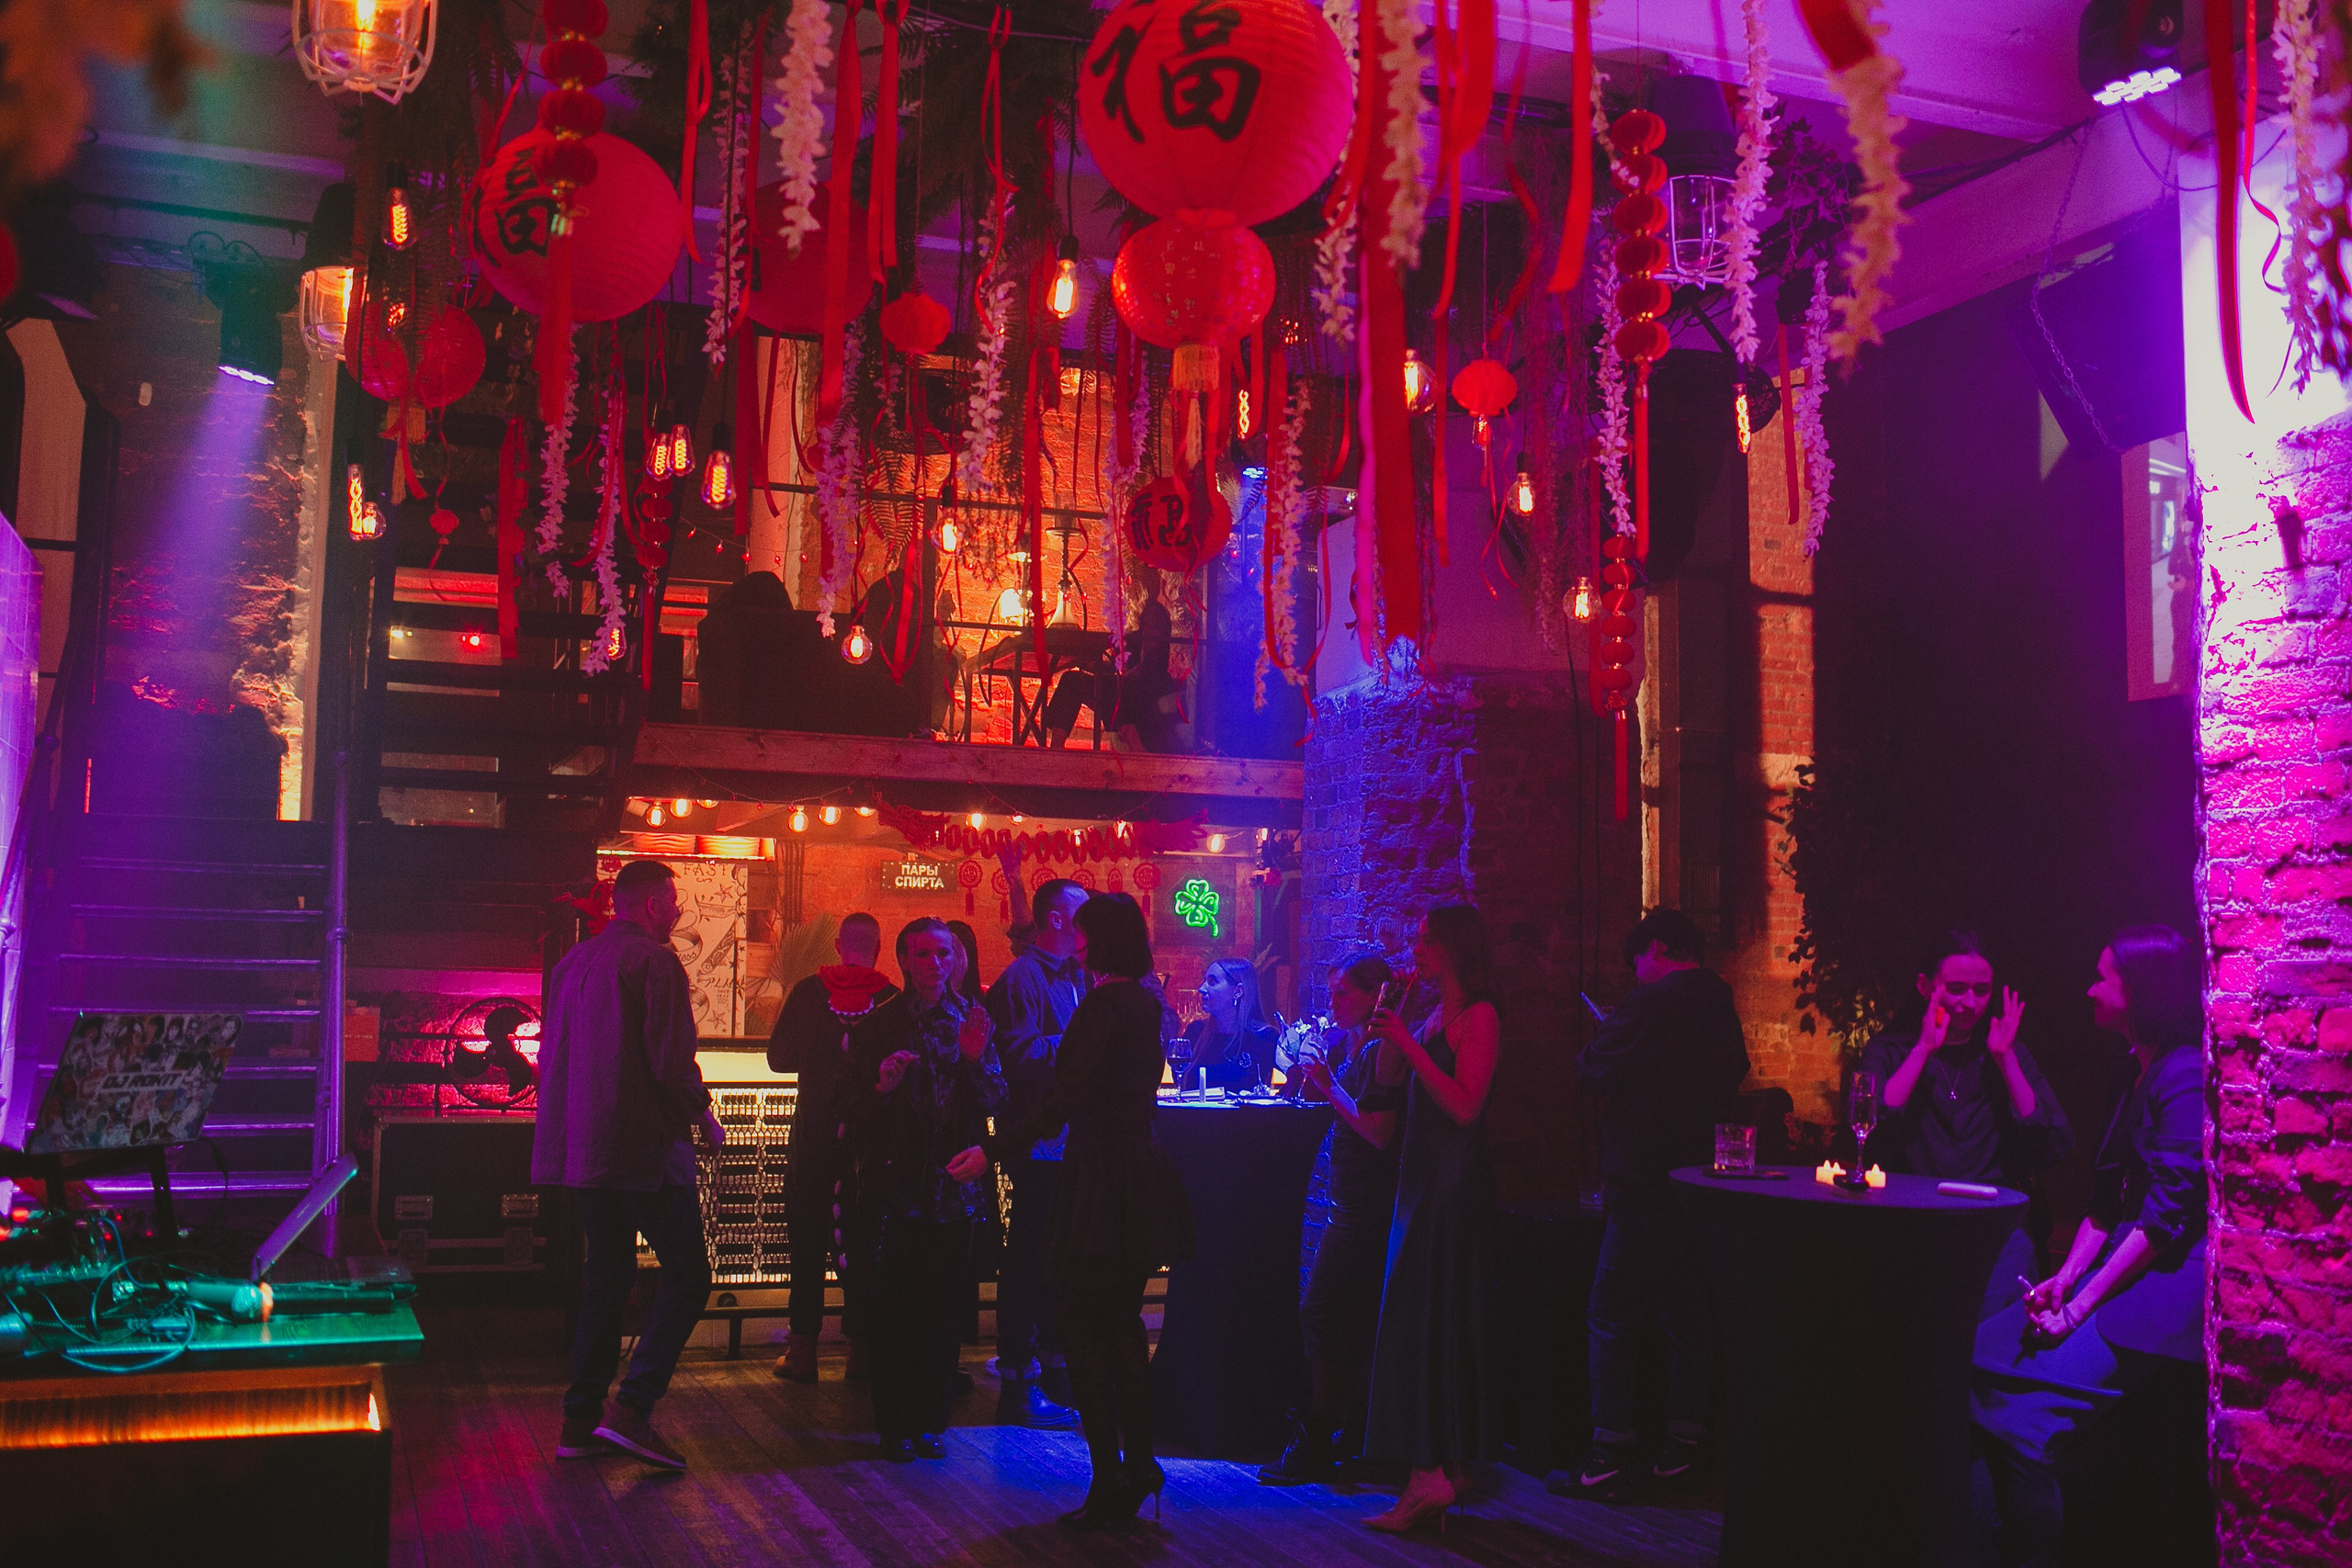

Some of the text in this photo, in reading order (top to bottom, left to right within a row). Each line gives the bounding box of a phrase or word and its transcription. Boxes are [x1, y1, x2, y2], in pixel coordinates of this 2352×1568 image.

[1091, 0, 1261, 142] 福
[683, 862, 729, 876] FAST
[901, 864, 938, 875] ПАРЫ
[895, 875, 944, 888] СПИРТА
